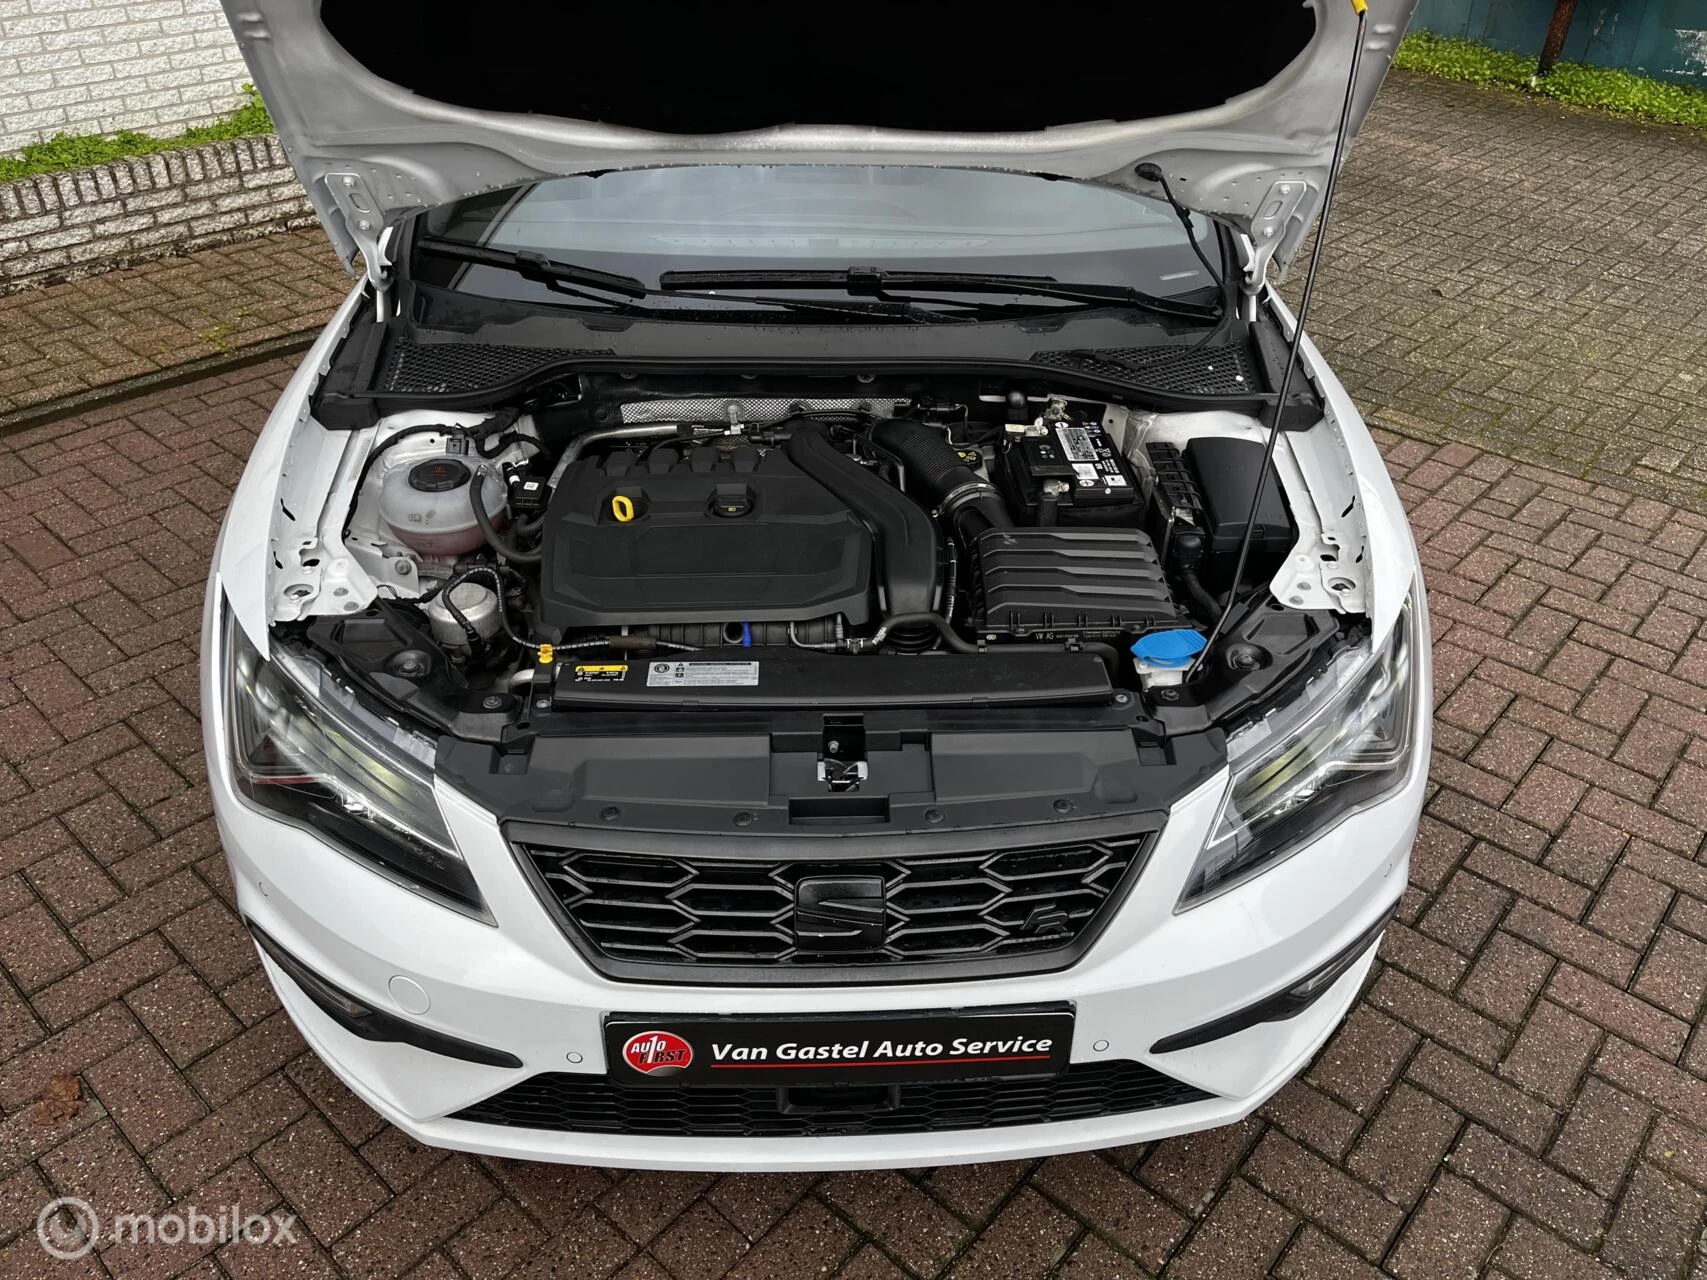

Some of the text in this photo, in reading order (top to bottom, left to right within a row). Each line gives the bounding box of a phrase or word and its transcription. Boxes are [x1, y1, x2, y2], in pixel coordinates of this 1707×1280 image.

[711, 1035, 1053, 1061] Van Gastel Auto Service
